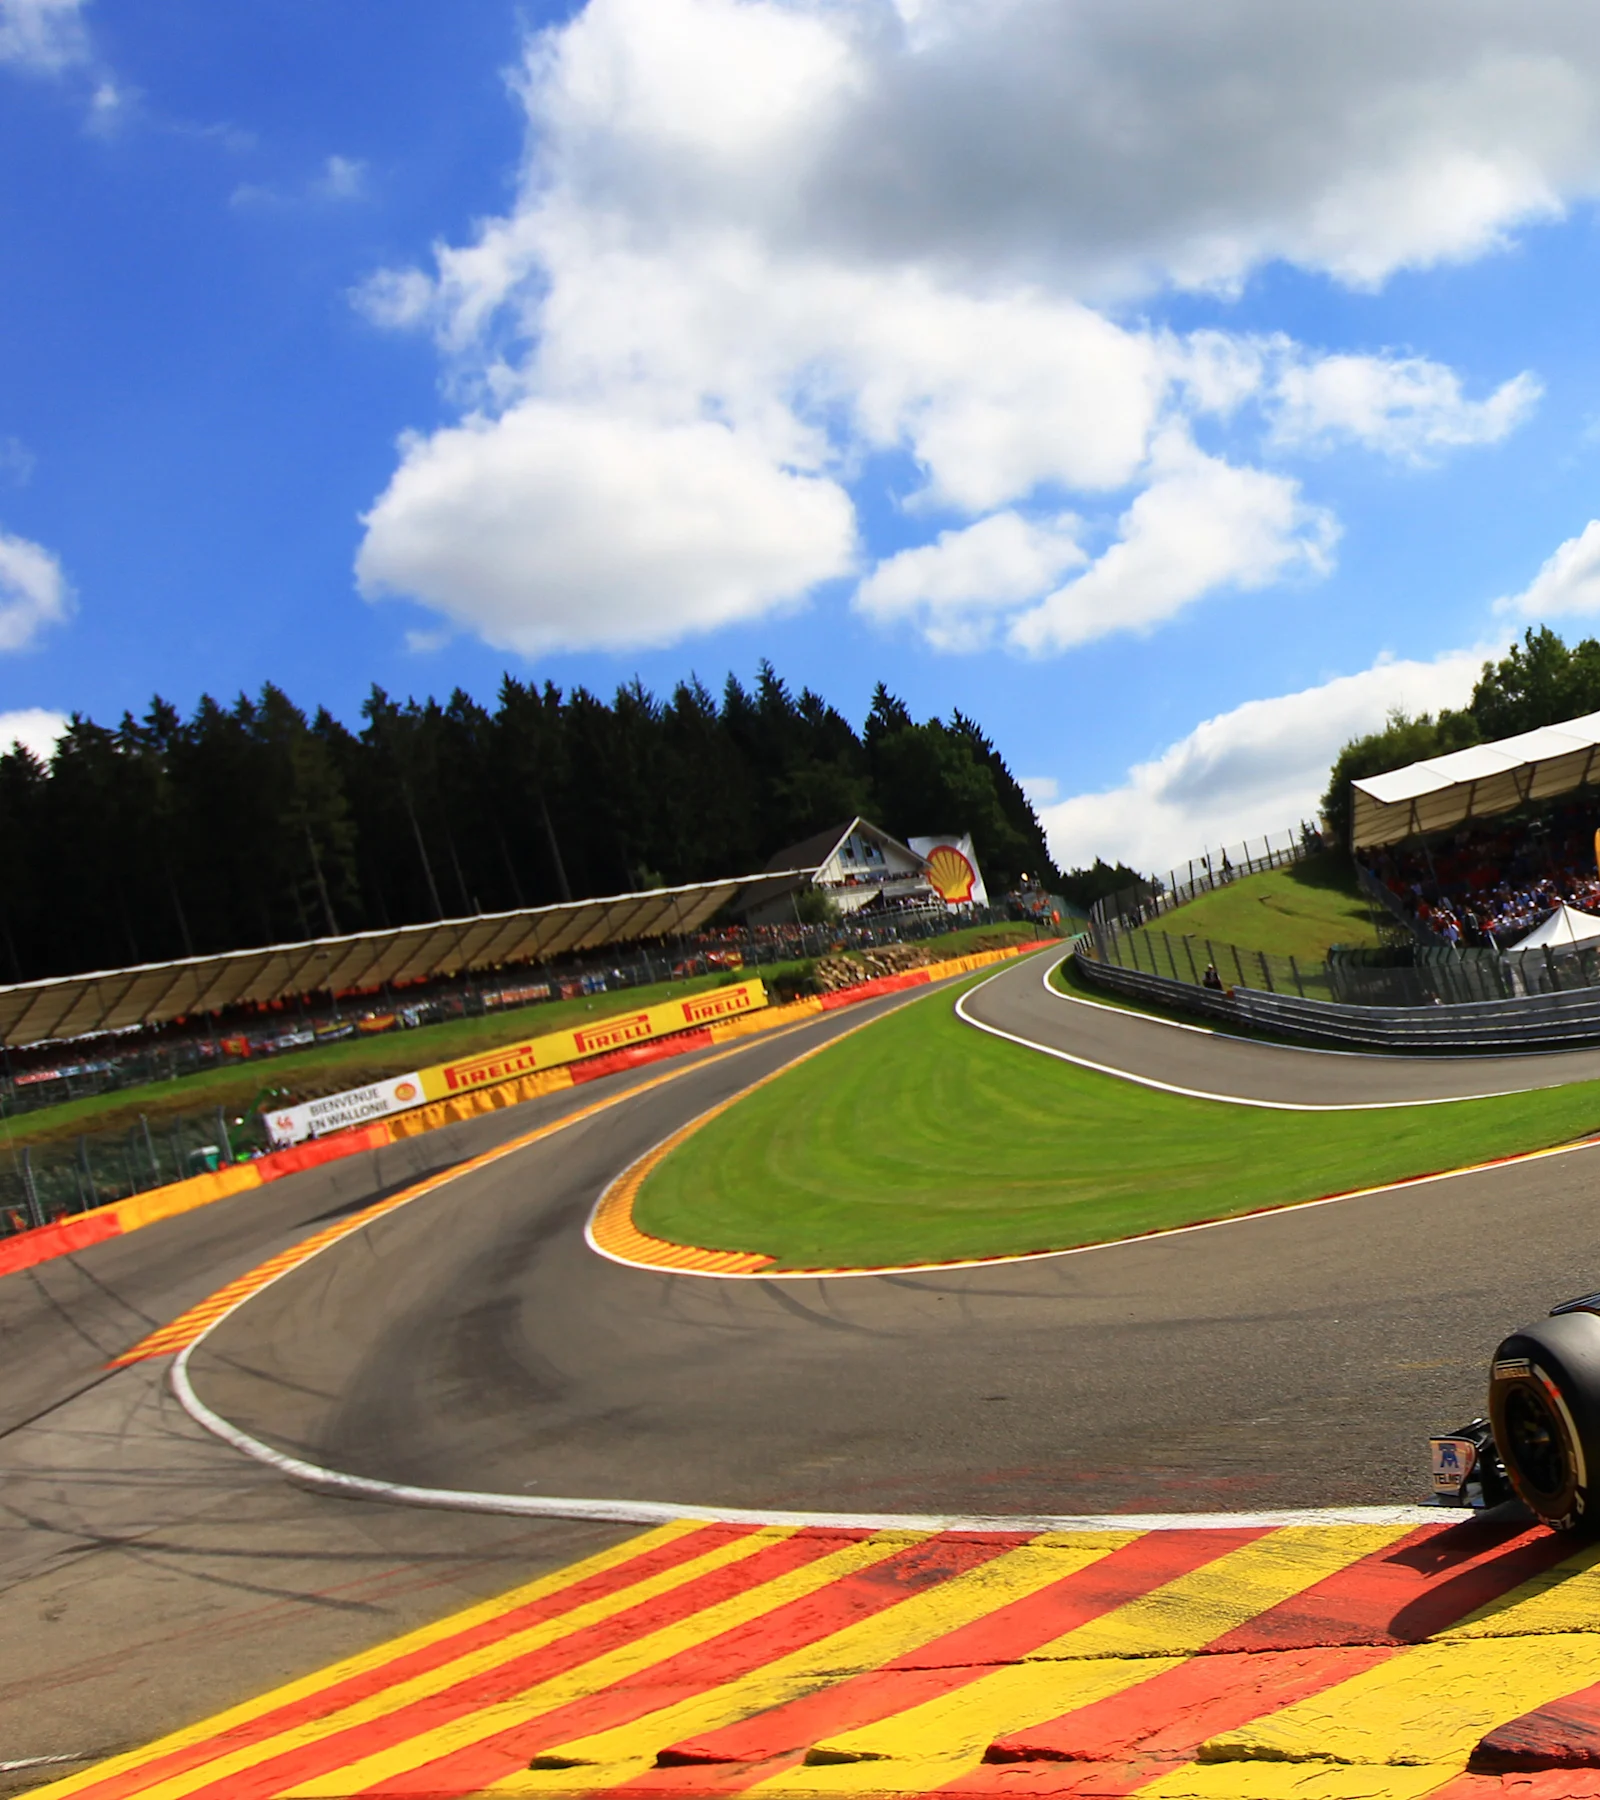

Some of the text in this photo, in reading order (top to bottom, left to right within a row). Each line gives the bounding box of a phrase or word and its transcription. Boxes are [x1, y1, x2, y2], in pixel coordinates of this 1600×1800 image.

[681, 987, 750, 1023] PIRELLI
[573, 1013, 652, 1053] PIRELLI
[443, 1045, 537, 1090] PIRELLI
[307, 1100, 390, 1133] EN WALLONIE
[309, 1087, 380, 1117] BIENVENUE
